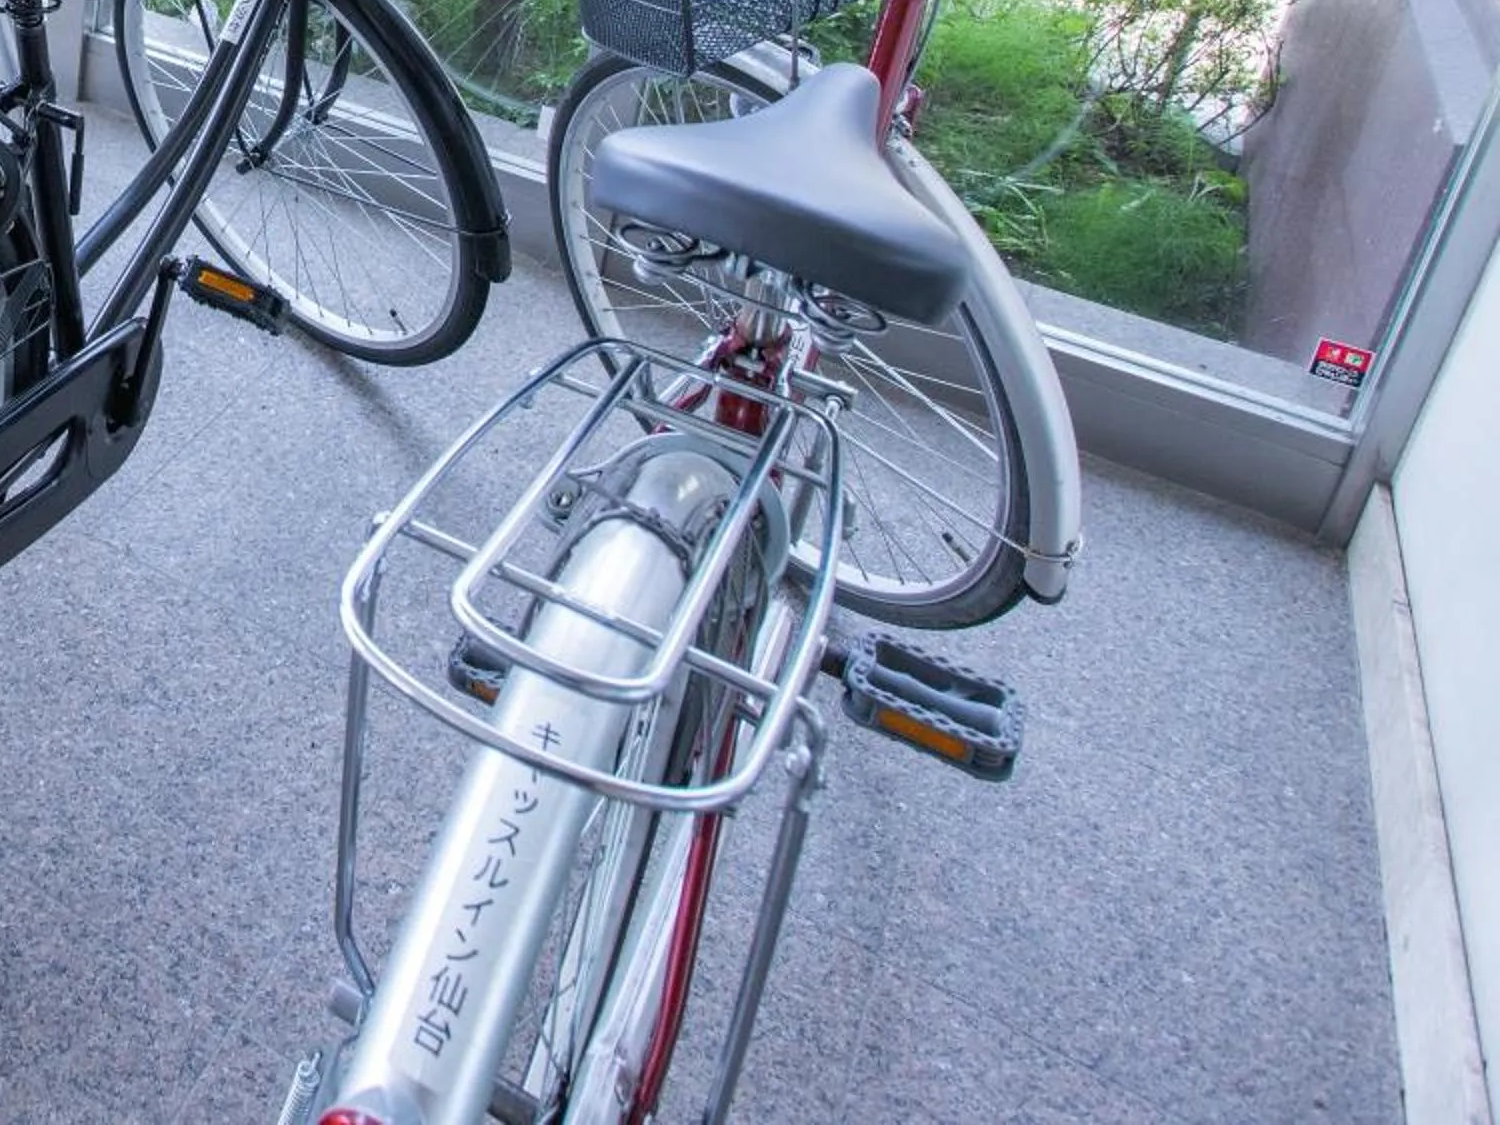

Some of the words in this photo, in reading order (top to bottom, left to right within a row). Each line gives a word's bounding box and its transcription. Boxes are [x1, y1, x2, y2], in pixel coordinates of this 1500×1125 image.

[414, 721, 562, 1059] キッスルイン仙台
